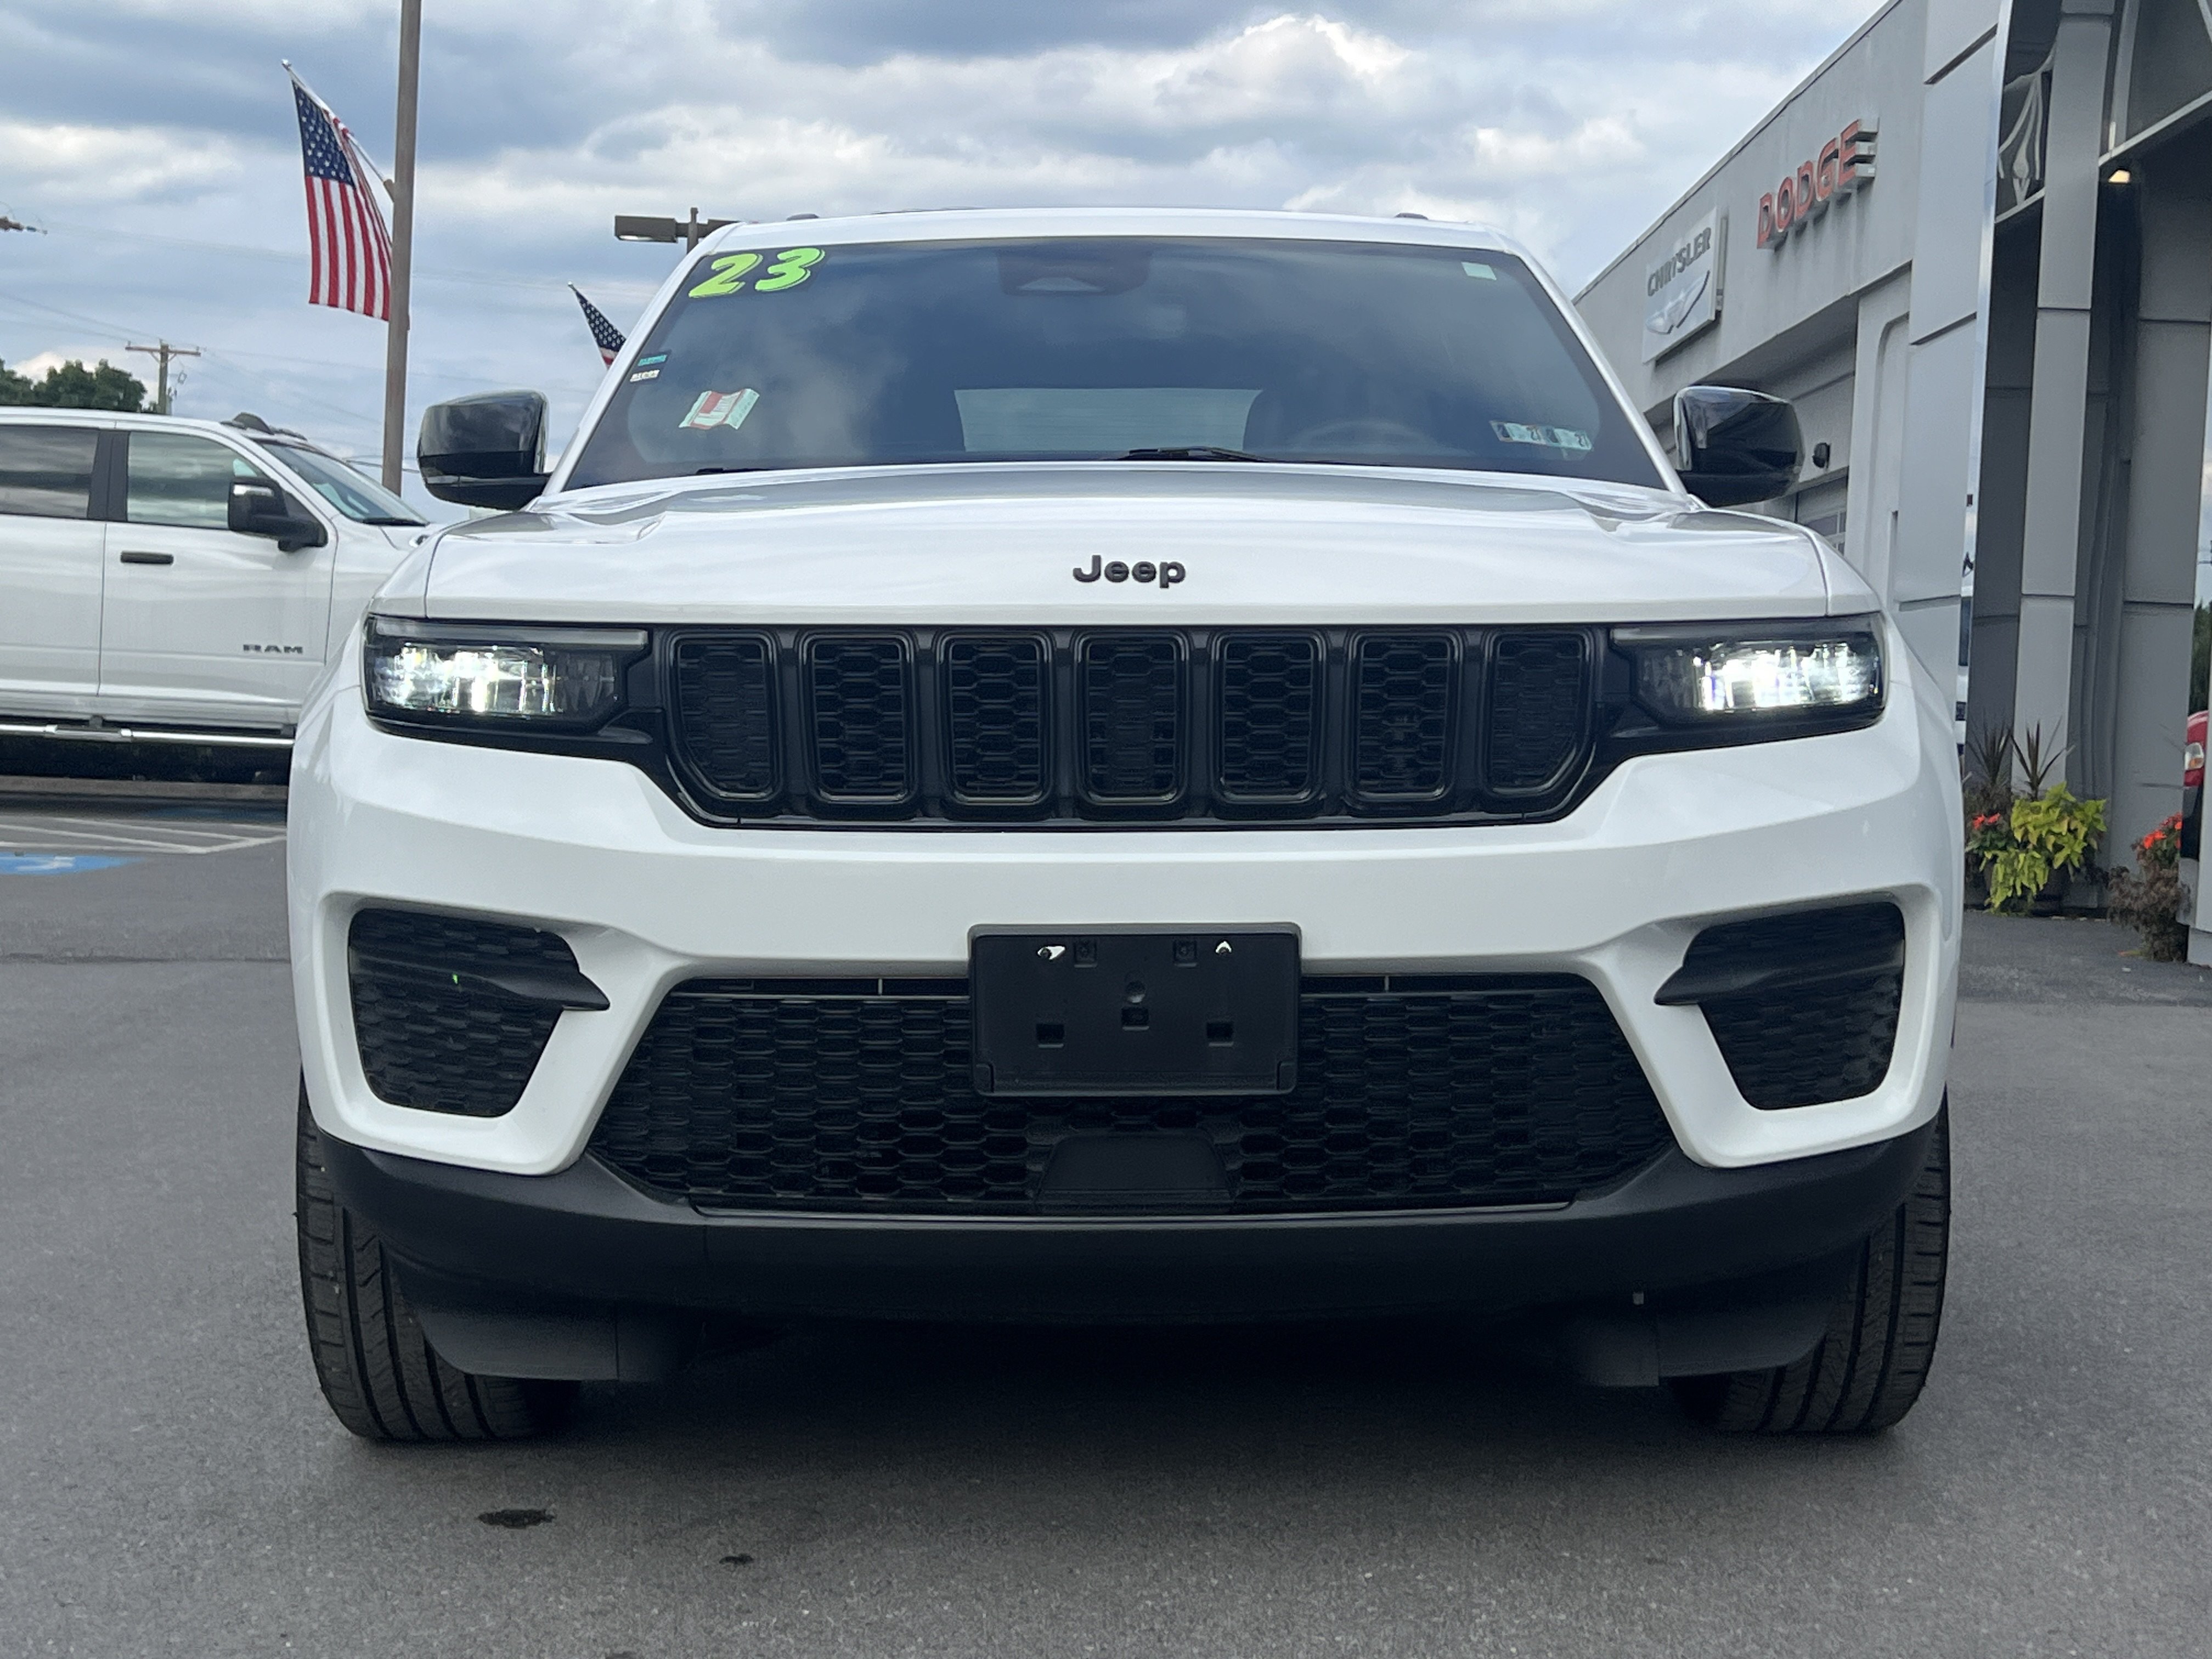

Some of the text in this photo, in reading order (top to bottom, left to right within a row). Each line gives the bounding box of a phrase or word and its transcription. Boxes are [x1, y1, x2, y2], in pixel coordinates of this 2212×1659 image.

[1757, 119, 1868, 249] DODGE
[689, 248, 825, 298] 23
[1647, 227, 1711, 296] CHRYSLER
[1073, 555, 1186, 589] Jeep
[243, 644, 303, 654] RAM
